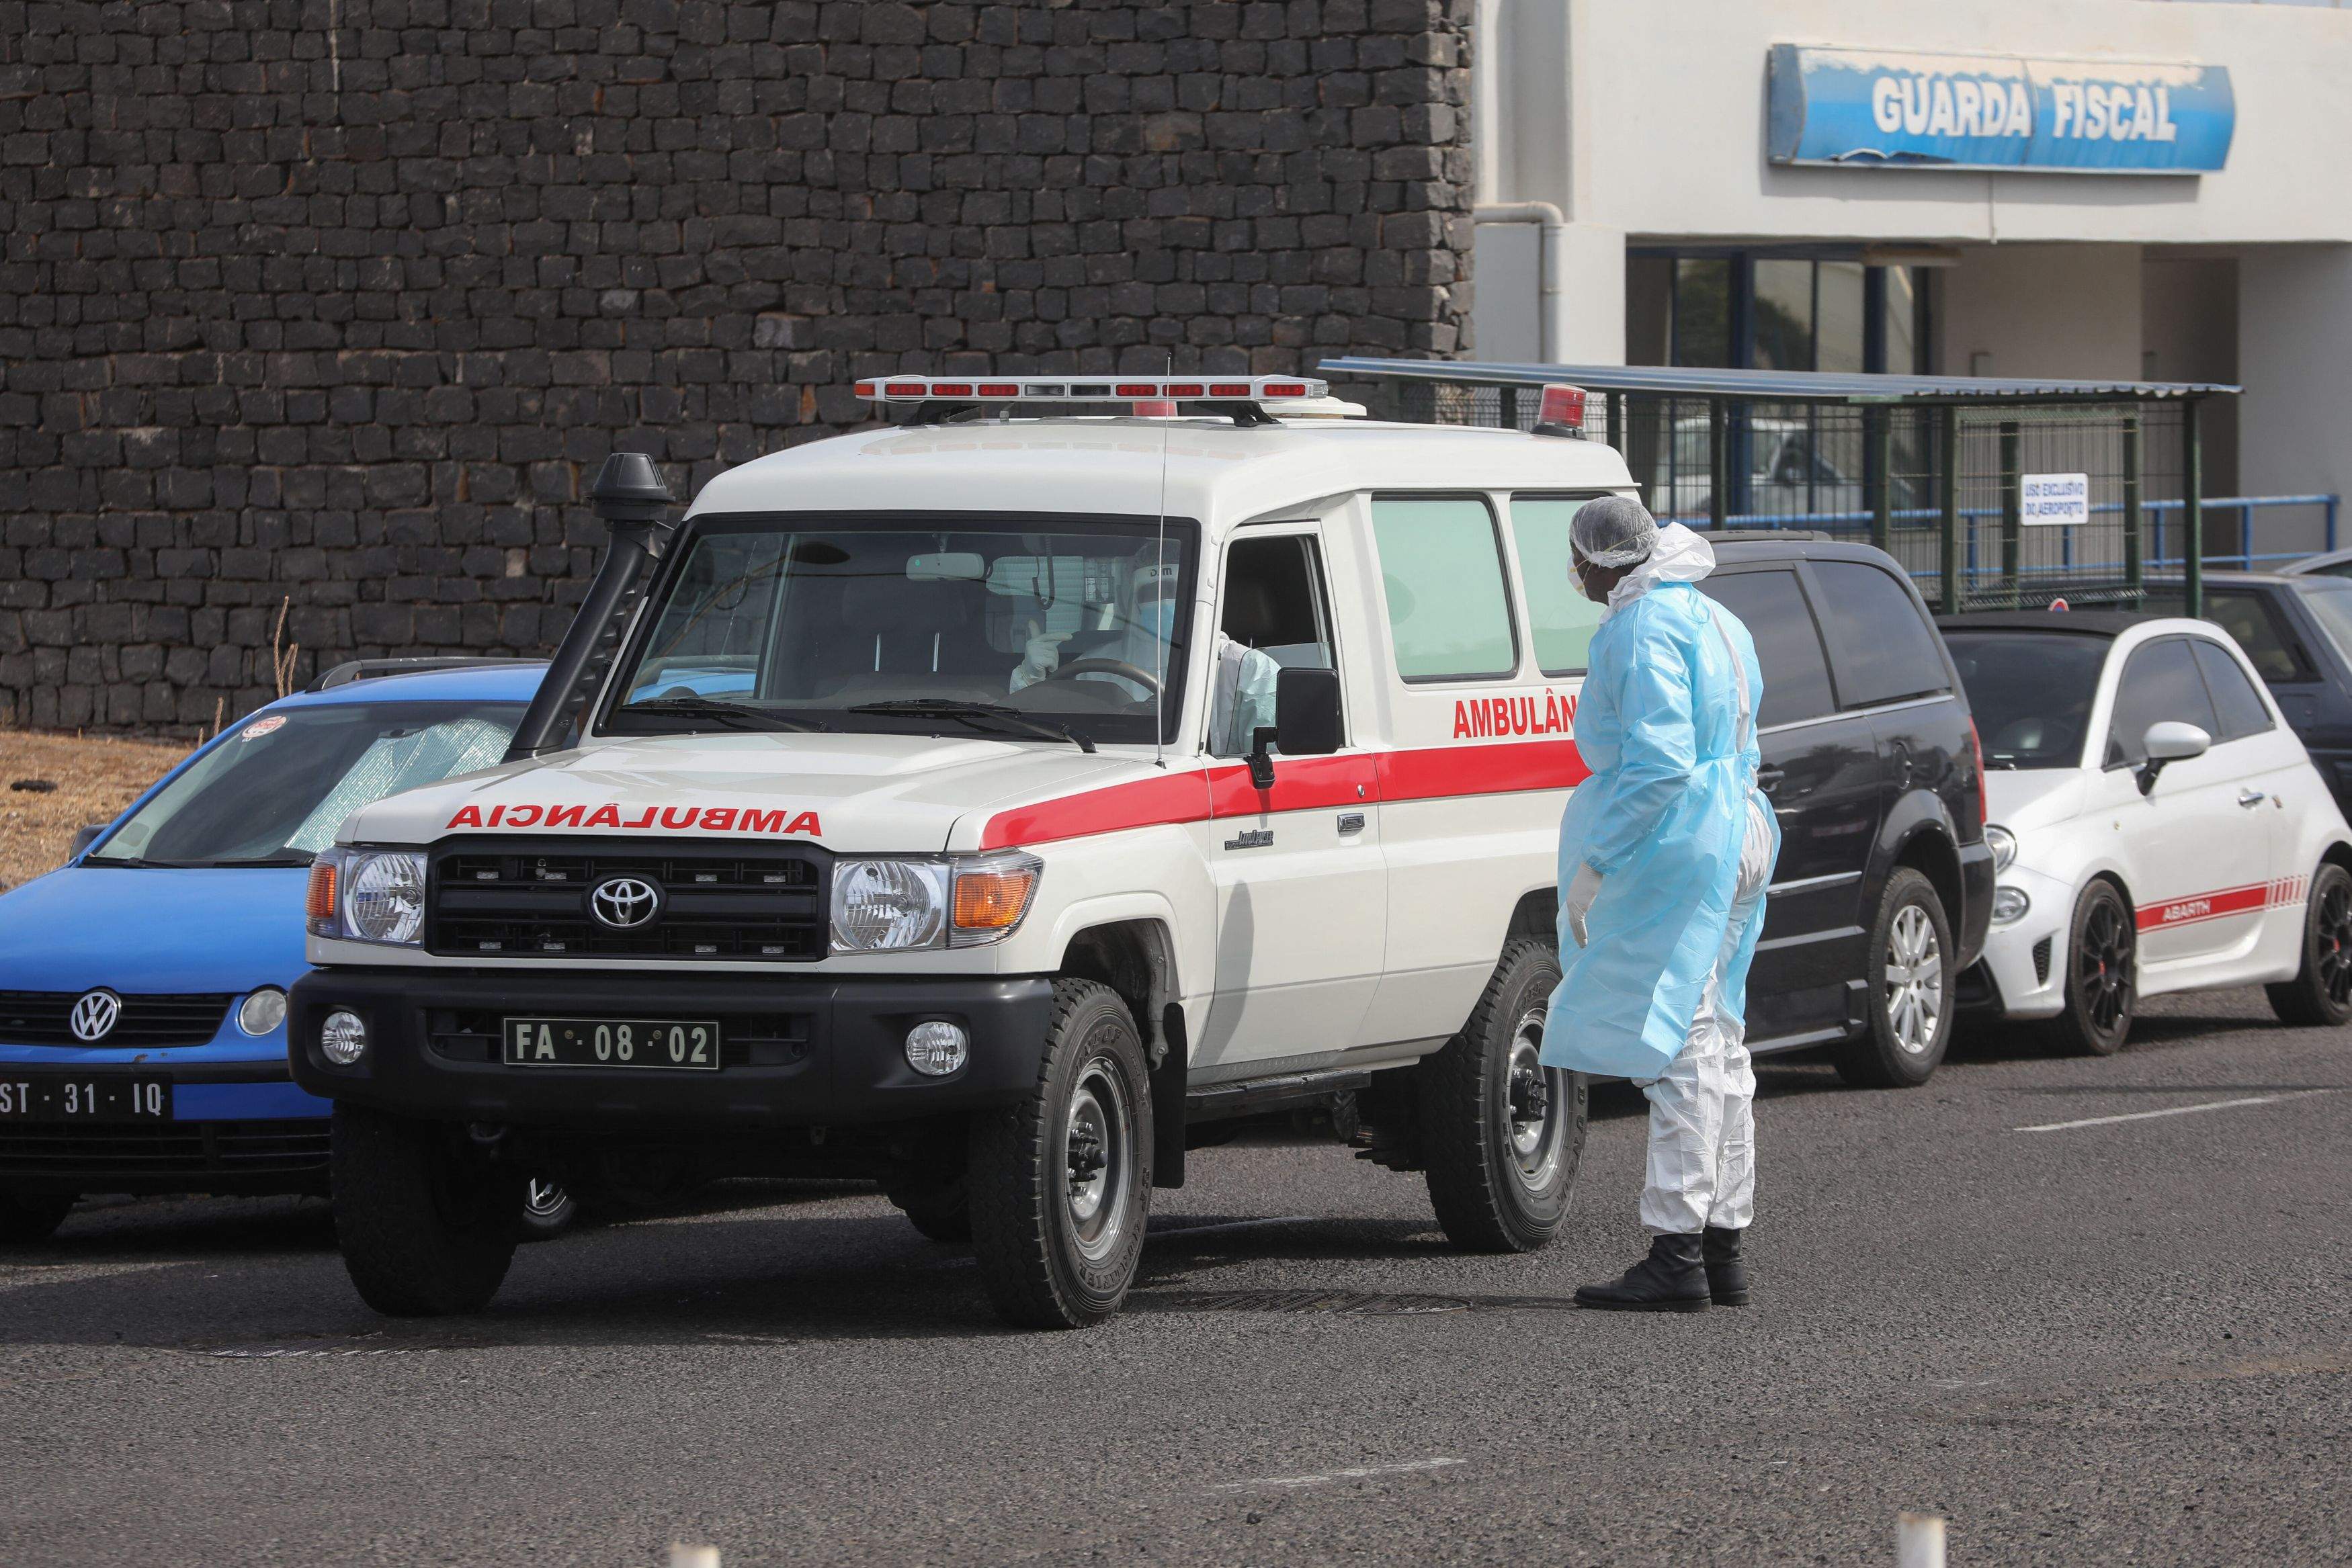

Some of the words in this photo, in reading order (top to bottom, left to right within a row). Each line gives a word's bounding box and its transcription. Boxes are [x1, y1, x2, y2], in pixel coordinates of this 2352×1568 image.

[1872, 75, 2033, 138] GUARDA
[2051, 83, 2177, 141] FISCAL
[2162, 899, 2211, 922] ABARTH
